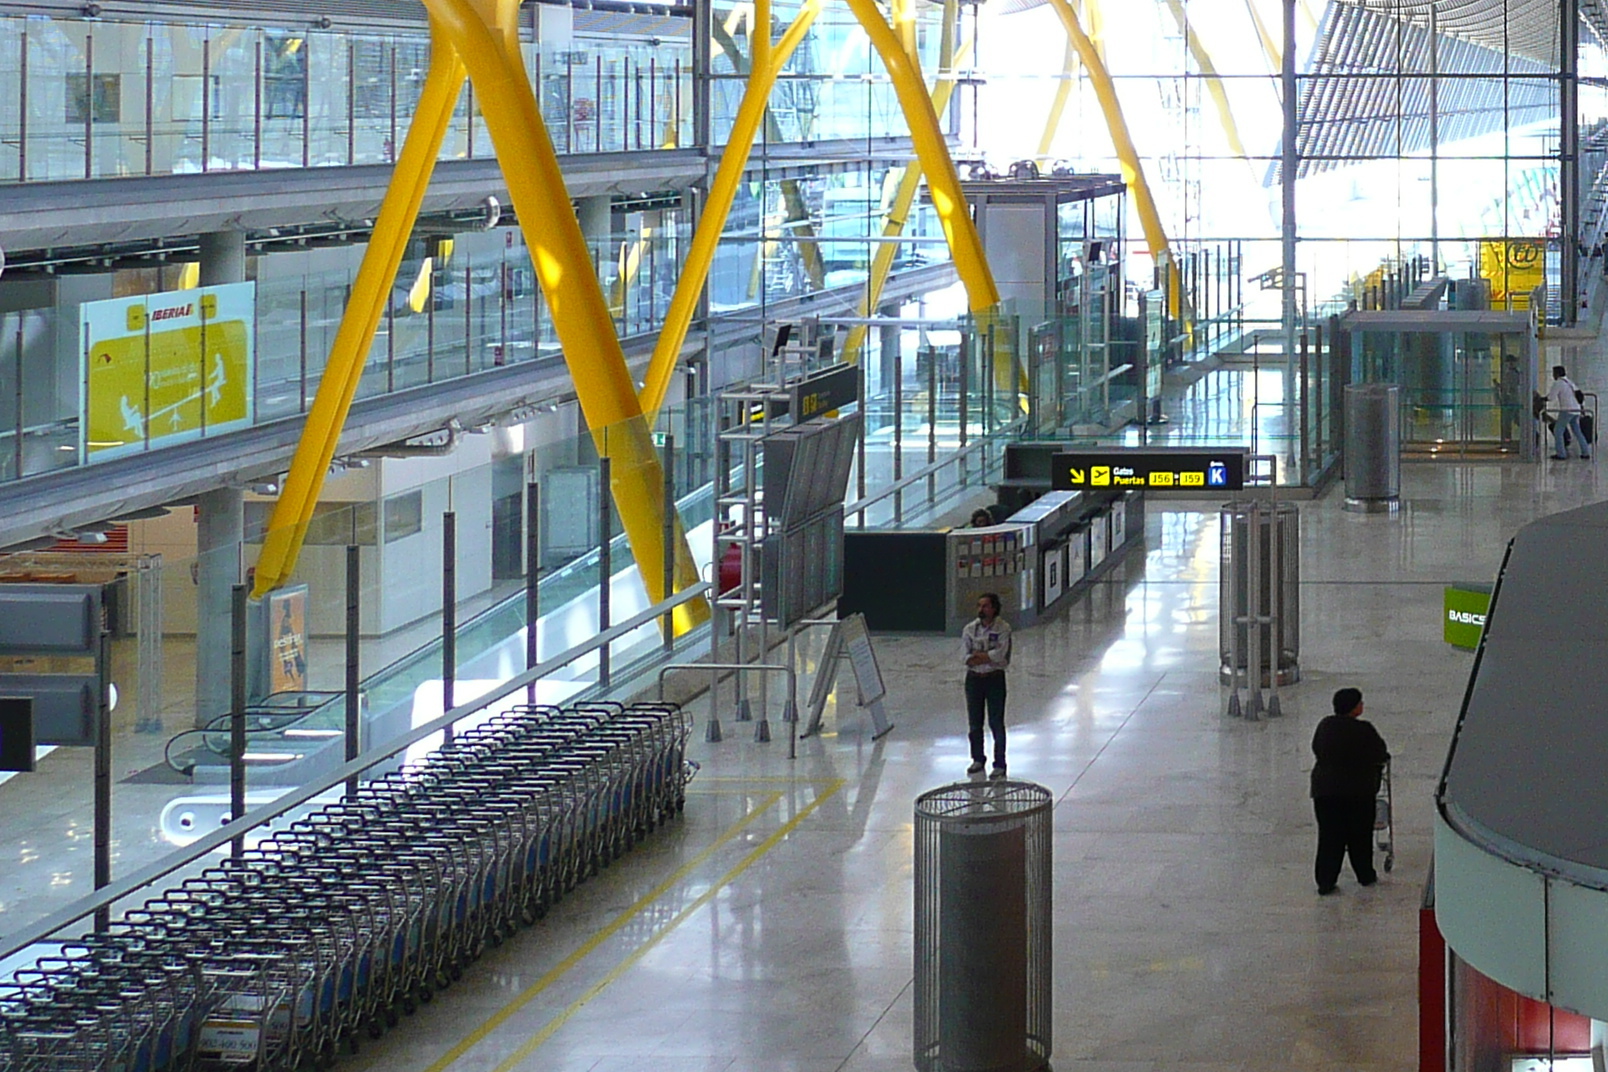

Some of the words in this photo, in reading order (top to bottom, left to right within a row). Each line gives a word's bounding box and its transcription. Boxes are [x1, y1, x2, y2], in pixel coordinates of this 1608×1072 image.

[151, 306, 186, 321] IBERIA
[1113, 466, 1134, 475] Gates
[1113, 476, 1145, 485] Puertas
[1211, 468, 1223, 484] K
[1448, 609, 1487, 625] BASICS
